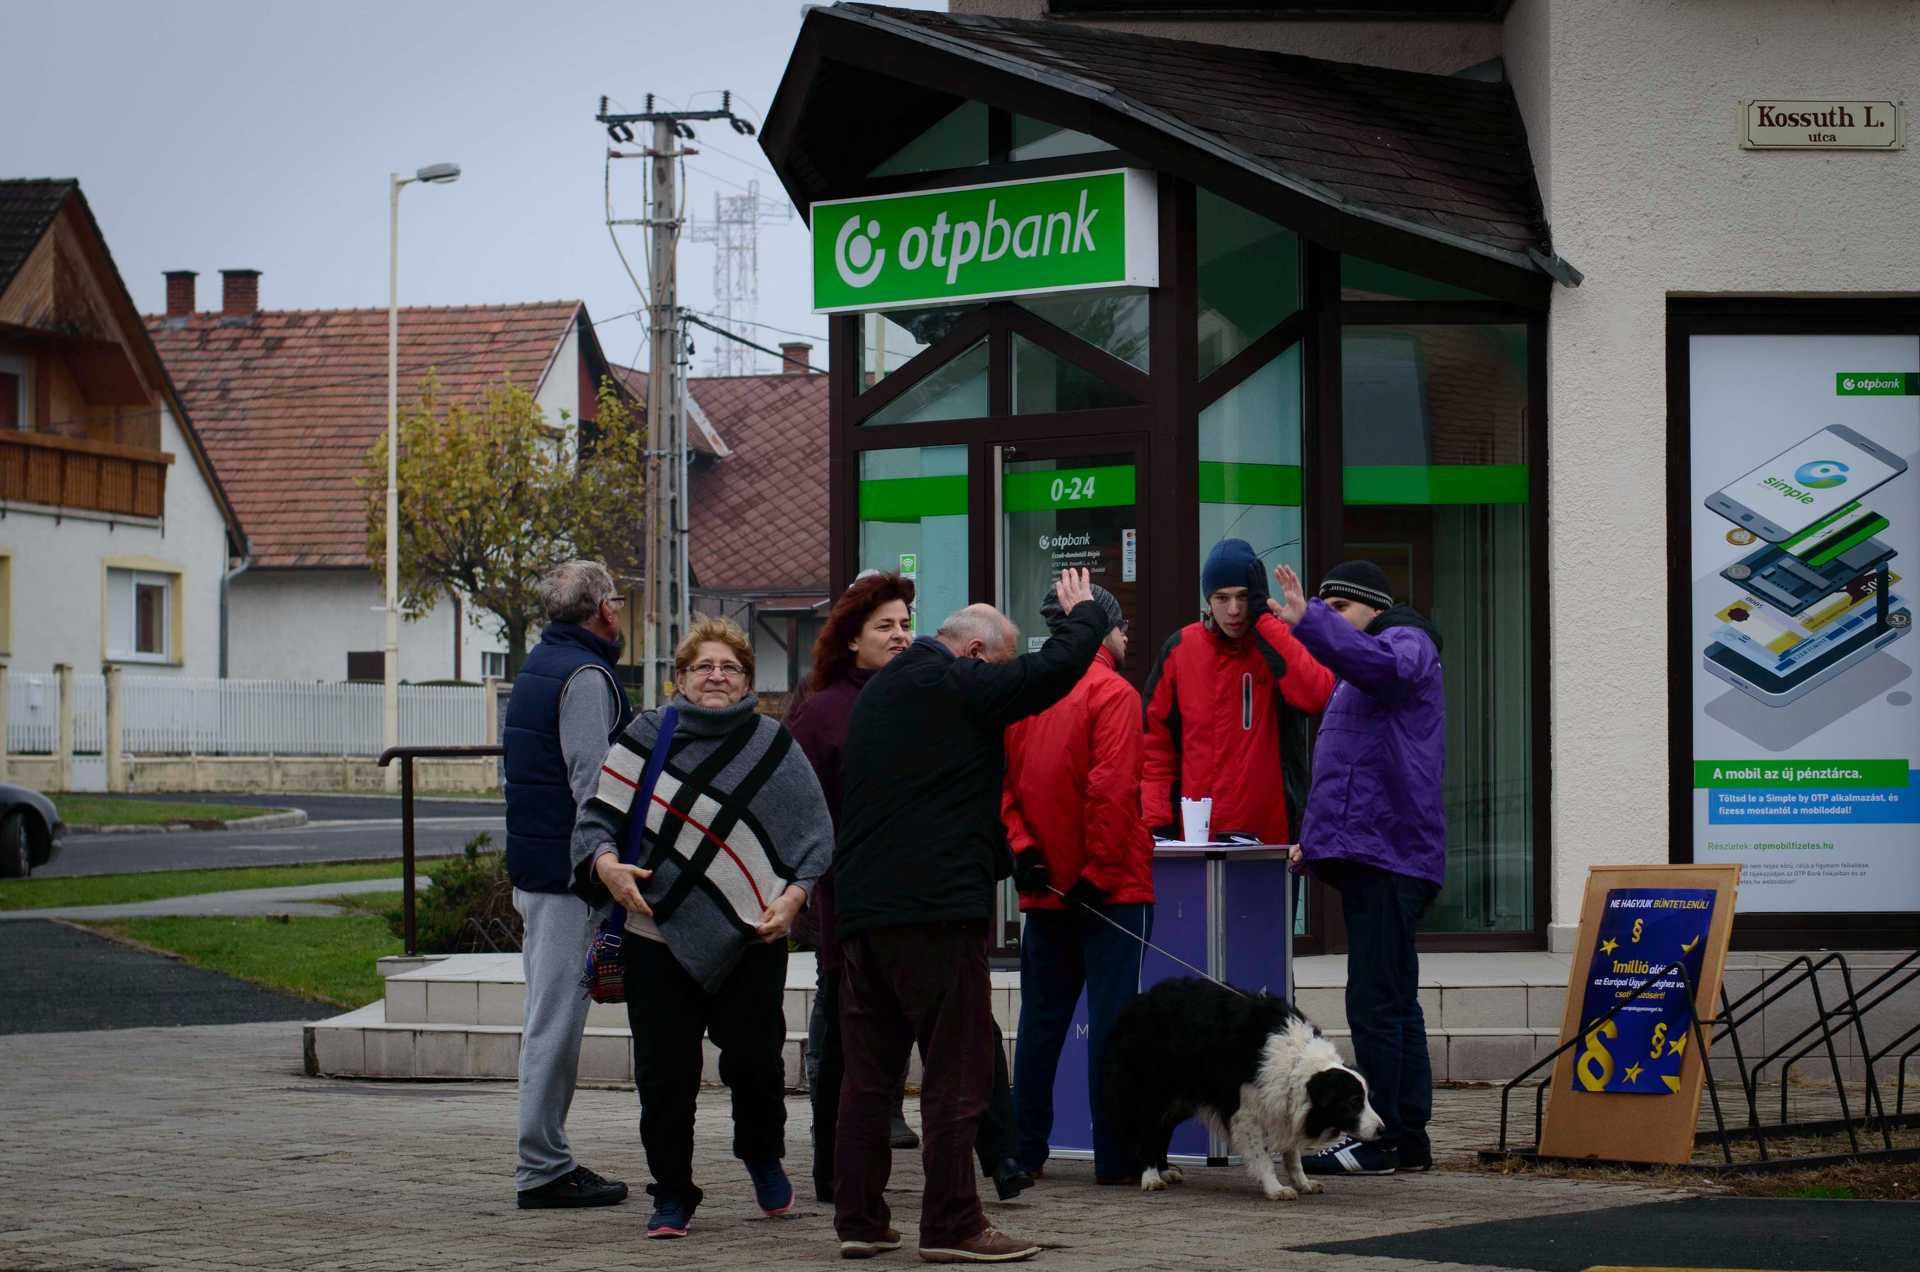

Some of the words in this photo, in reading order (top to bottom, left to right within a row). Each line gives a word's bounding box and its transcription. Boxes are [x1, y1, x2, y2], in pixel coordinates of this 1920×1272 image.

[1757, 105, 1855, 128] Kossuth
[1863, 105, 1885, 128] L.
[1808, 132, 1837, 143] utca
[899, 188, 1100, 285] otpbank
[1857, 378, 1900, 391] otpbank
[1050, 476, 1096, 502] 0-24
[1762, 475, 1815, 505] simple
[1051, 532, 1090, 550] otpbank
[1712, 767, 1723, 780] A
[1725, 767, 1762, 780] mobil
[1764, 769, 1779, 780] az
[1782, 767, 1794, 781] új
[1797, 766, 1863, 781] pénztárca.
[1719, 793, 1747, 802] Töltsd
[1748, 794, 1756, 803] le
[1766, 793, 1797, 804] Simple
[1798, 794, 1809, 804] by
[1810, 793, 1829, 802] OTP
[1888, 792, 1899, 802] és
[1719, 806, 1745, 815] fizess
[1747, 805, 1791, 815] mostantól
[1792, 807, 1798, 815] a
[1800, 806, 1852, 815] mobiloddal!
[1609, 899, 1622, 909] NE
[1621, 899, 1653, 909] HAGYJUK
[1653, 897, 1710, 910] BÜNTETLENÜL!
